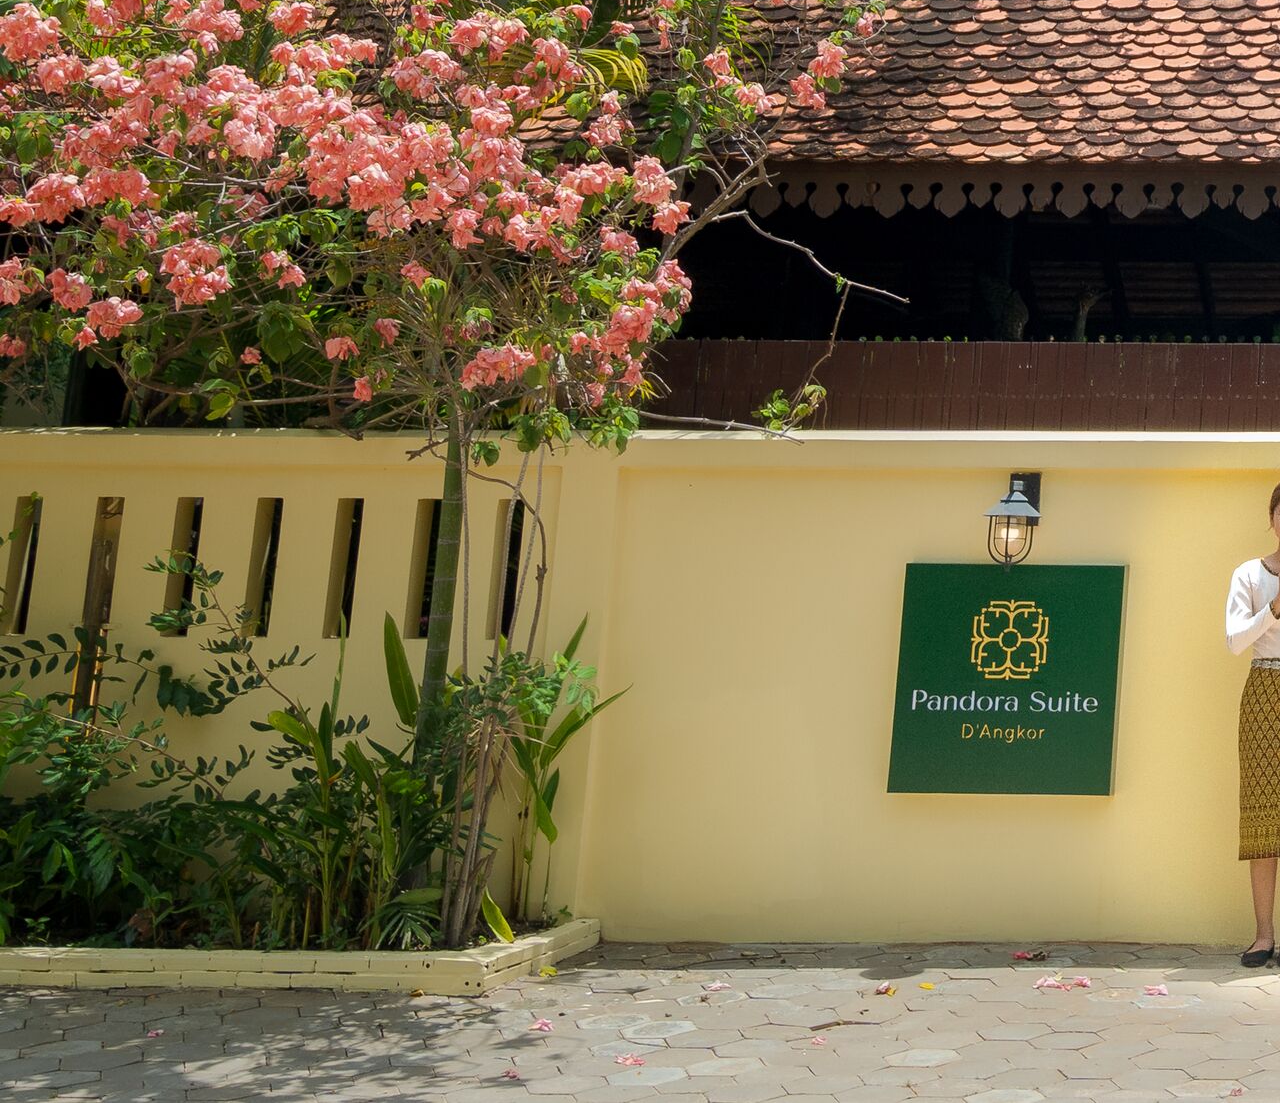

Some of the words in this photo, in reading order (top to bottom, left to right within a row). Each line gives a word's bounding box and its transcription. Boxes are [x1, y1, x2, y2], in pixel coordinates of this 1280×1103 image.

[911, 689, 1019, 712] Pandora
[1029, 691, 1099, 713] Suite
[961, 723, 1046, 744] D'Angkor
